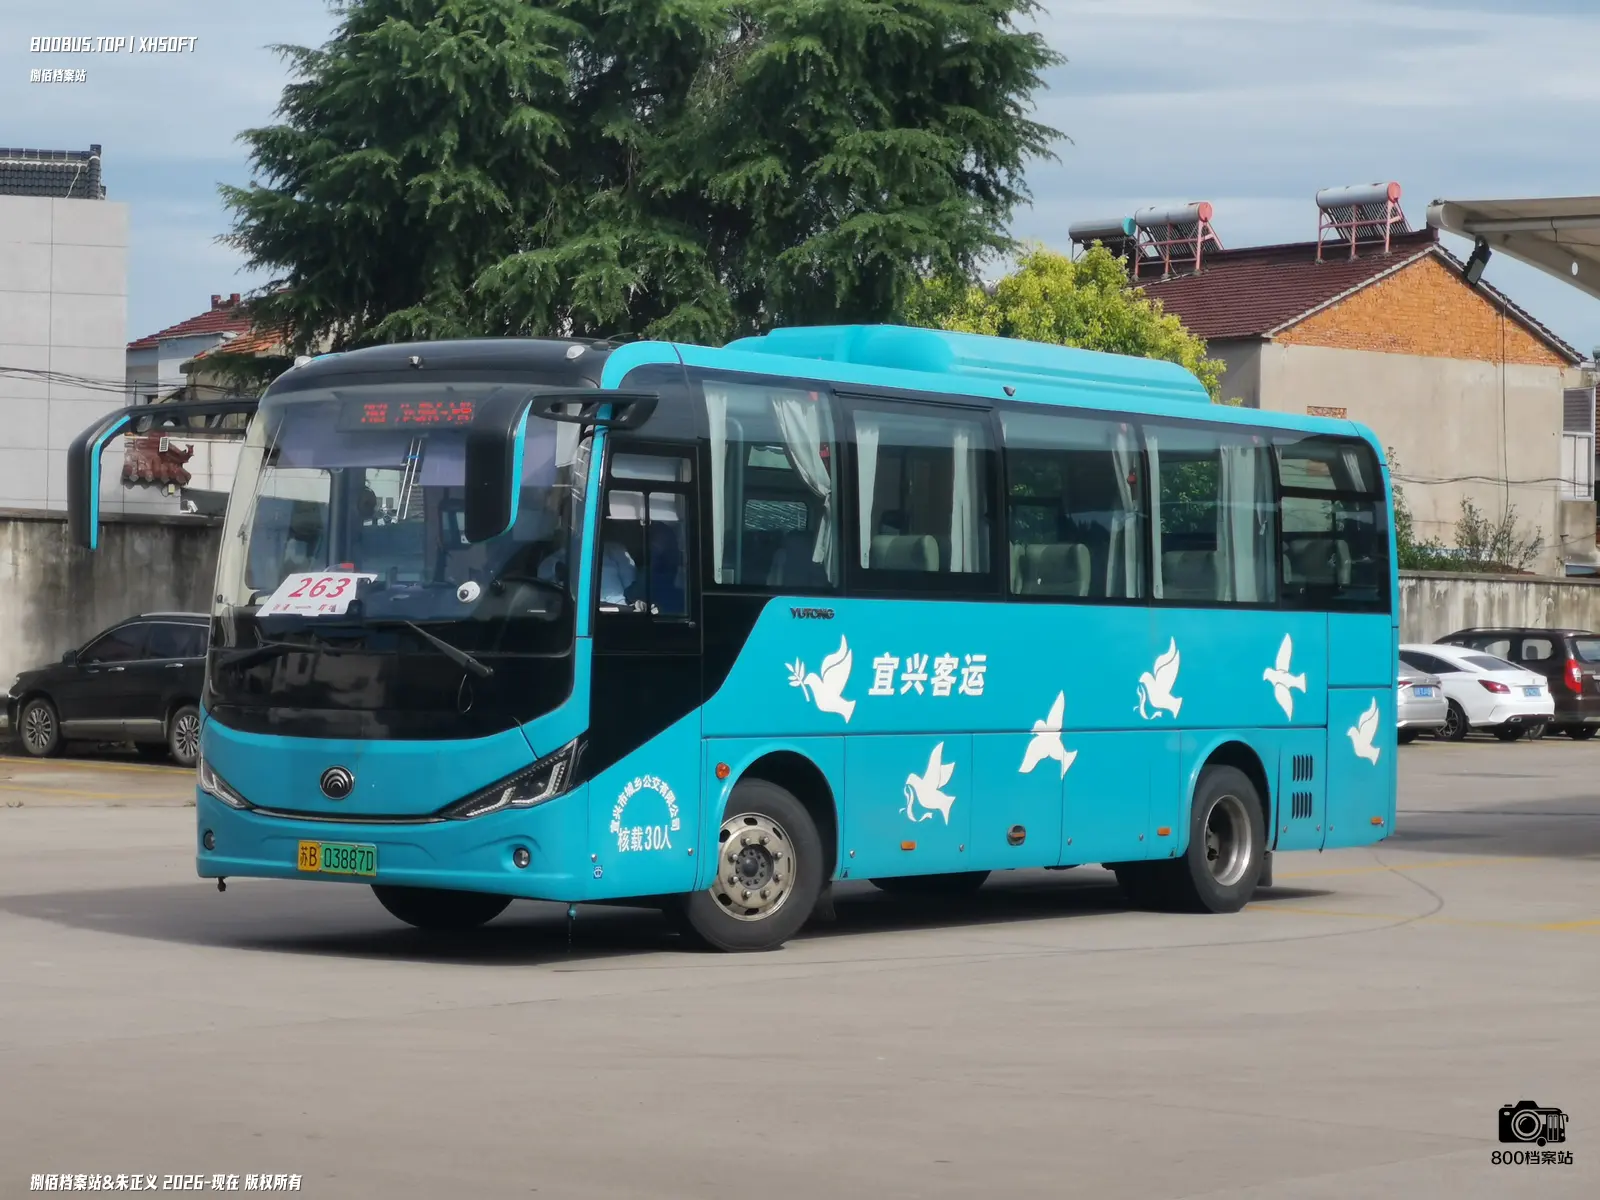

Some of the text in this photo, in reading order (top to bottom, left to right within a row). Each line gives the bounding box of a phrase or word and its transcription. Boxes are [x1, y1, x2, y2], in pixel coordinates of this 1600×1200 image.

[287, 577, 352, 599] 263
[789, 607, 835, 620] YUTONG
[868, 652, 987, 697] 宜兴客运
[617, 824, 672, 853] 核载30人
